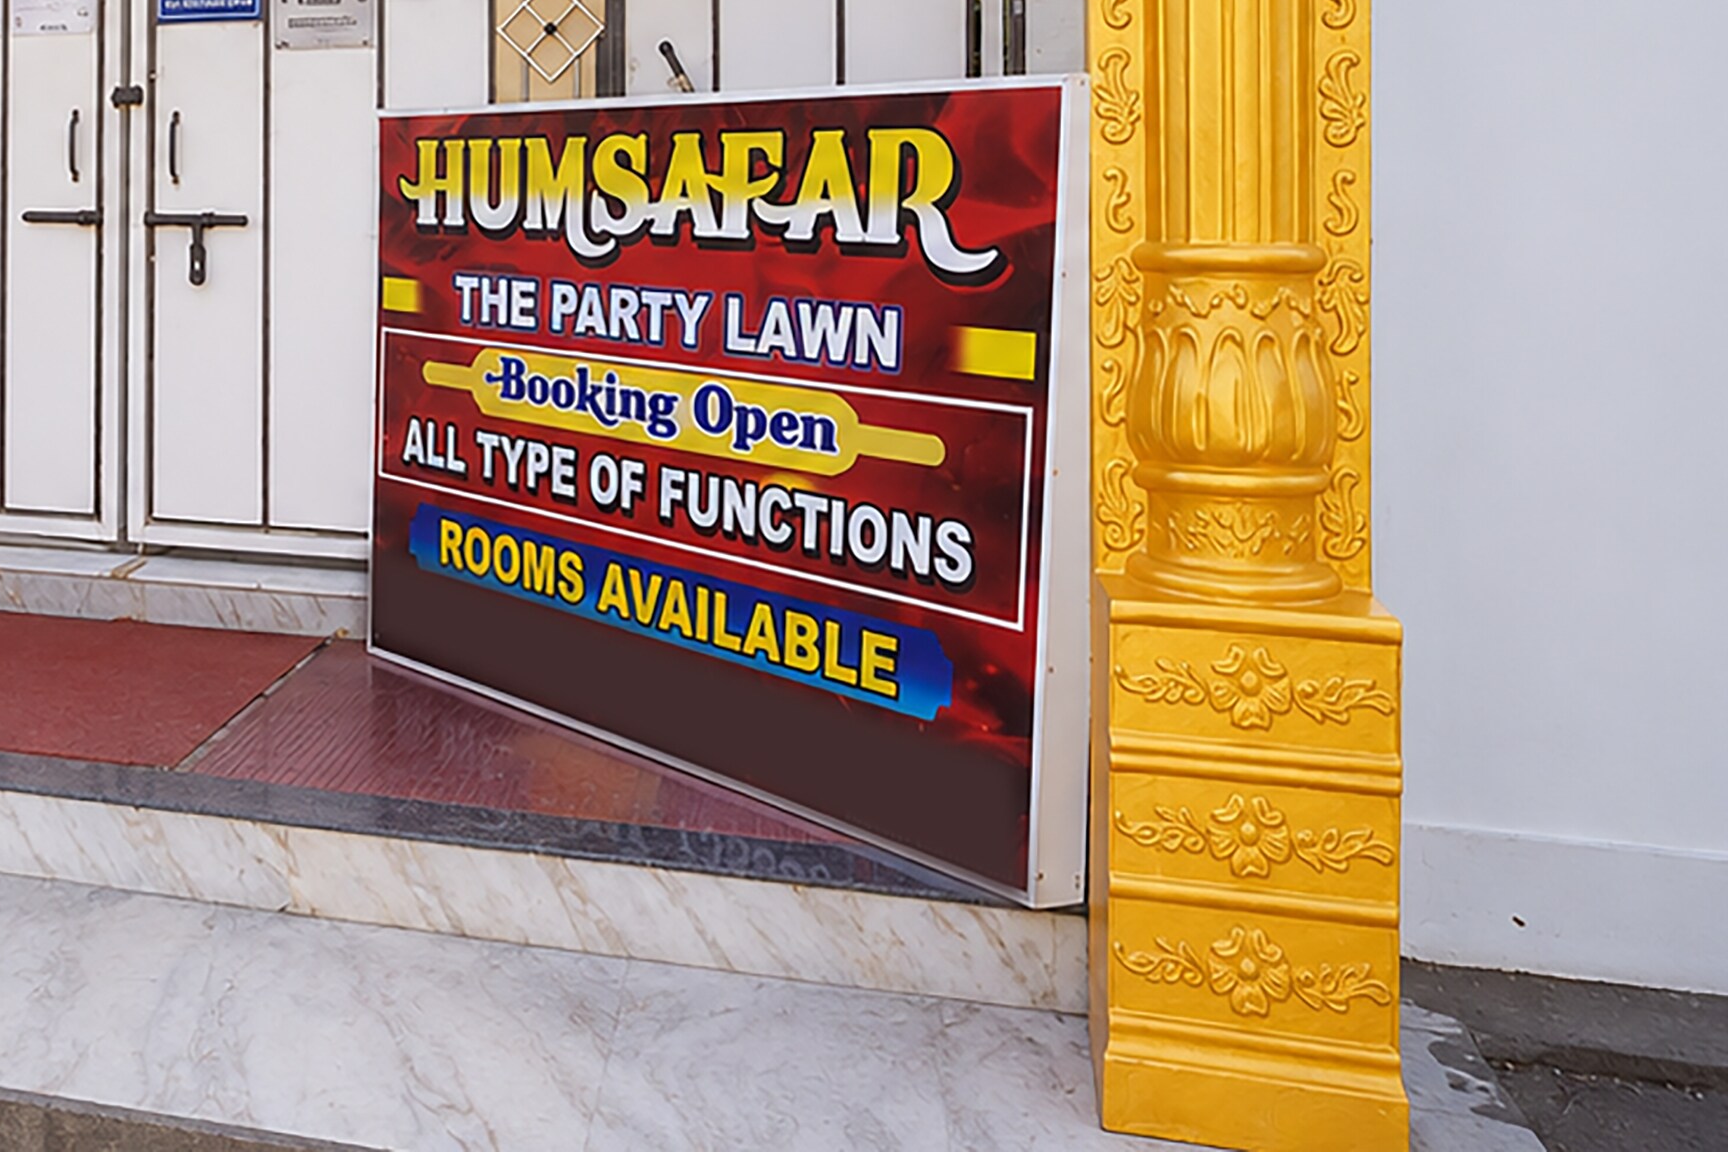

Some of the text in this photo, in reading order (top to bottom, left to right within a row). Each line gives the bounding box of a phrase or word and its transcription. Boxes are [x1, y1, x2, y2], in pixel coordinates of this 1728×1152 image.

[399, 127, 1001, 274] HUMSAFAR
[454, 274, 902, 374] THE PARTY LAWN
[485, 353, 839, 454] Booking Open
[403, 418, 973, 585] ALL TYPE OF FUNCTIONS
[439, 517, 899, 697] ROOMS AVAILABLE
